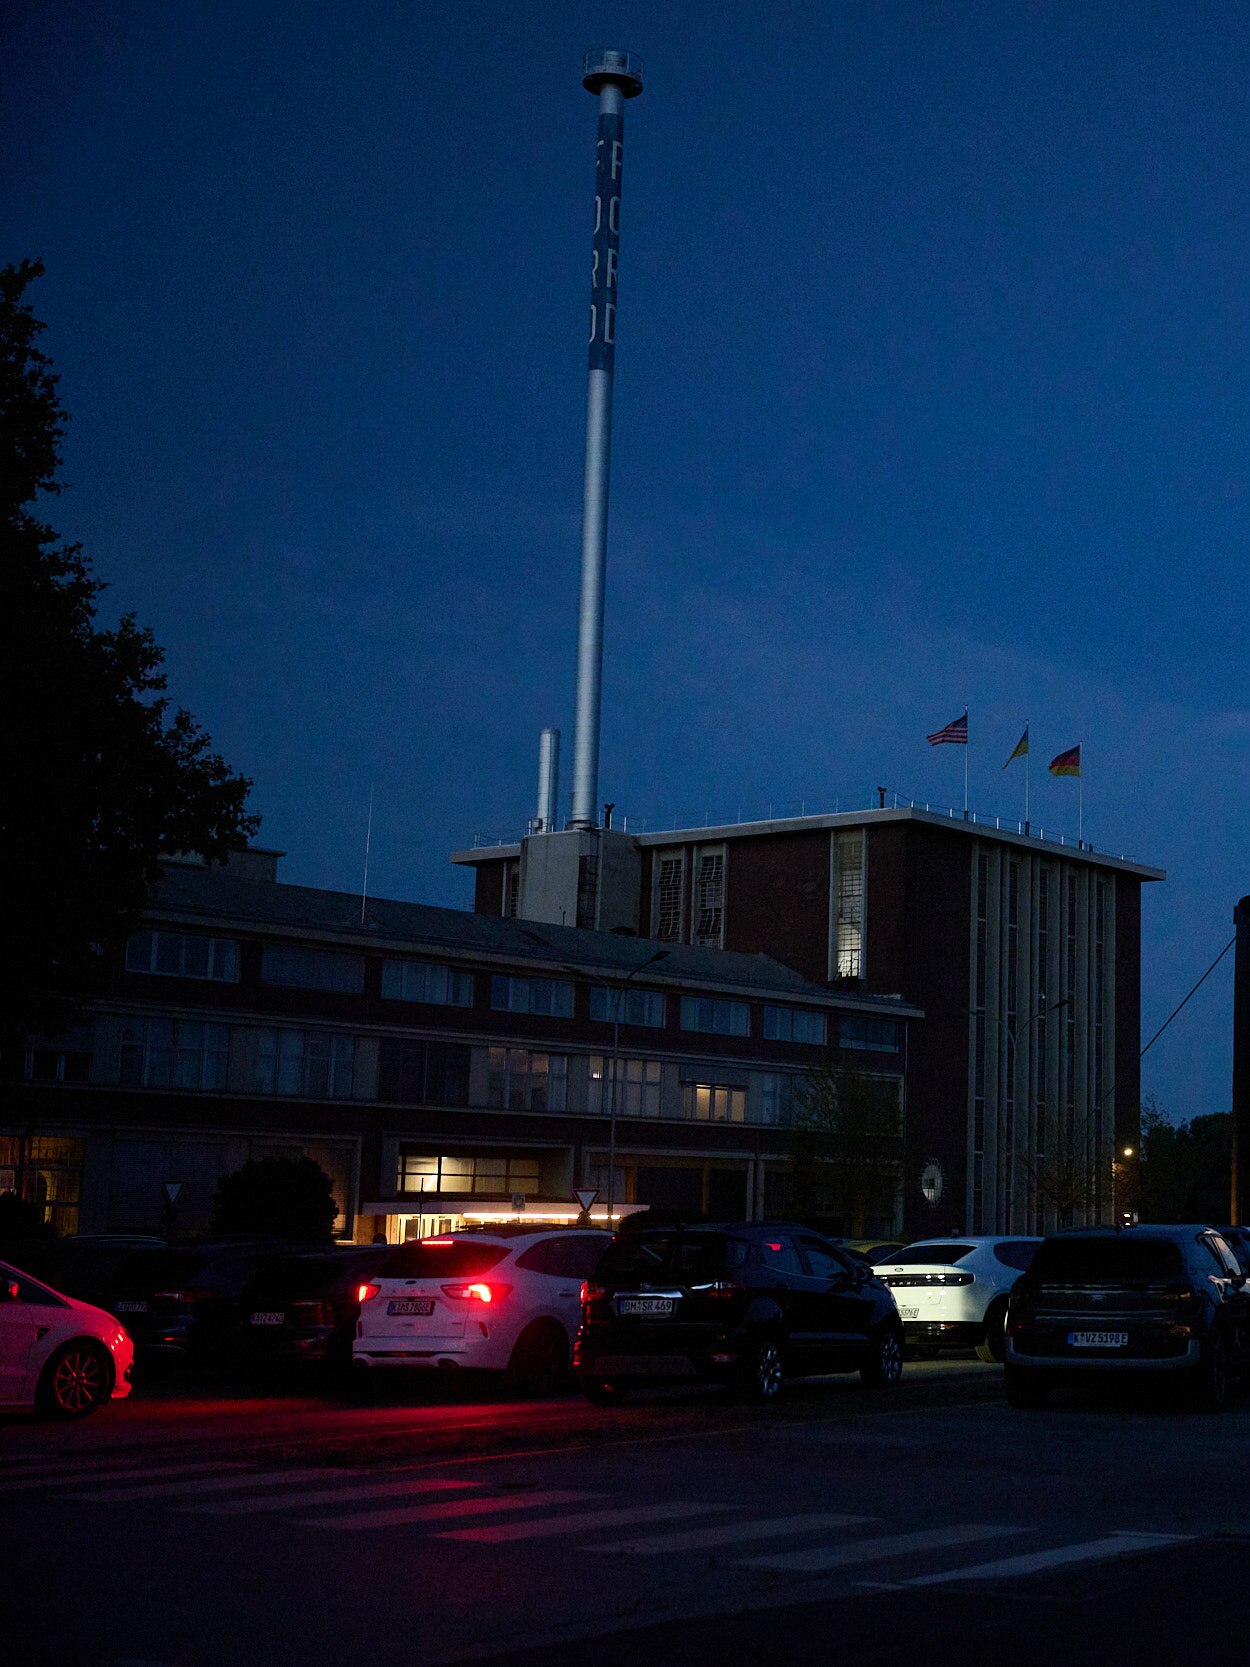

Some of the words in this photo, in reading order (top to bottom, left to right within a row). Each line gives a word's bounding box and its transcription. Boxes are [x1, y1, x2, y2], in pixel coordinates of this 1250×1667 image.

[625, 1301, 637, 1311] BM
[642, 1301, 654, 1311] SR
[655, 1301, 672, 1311] 469
